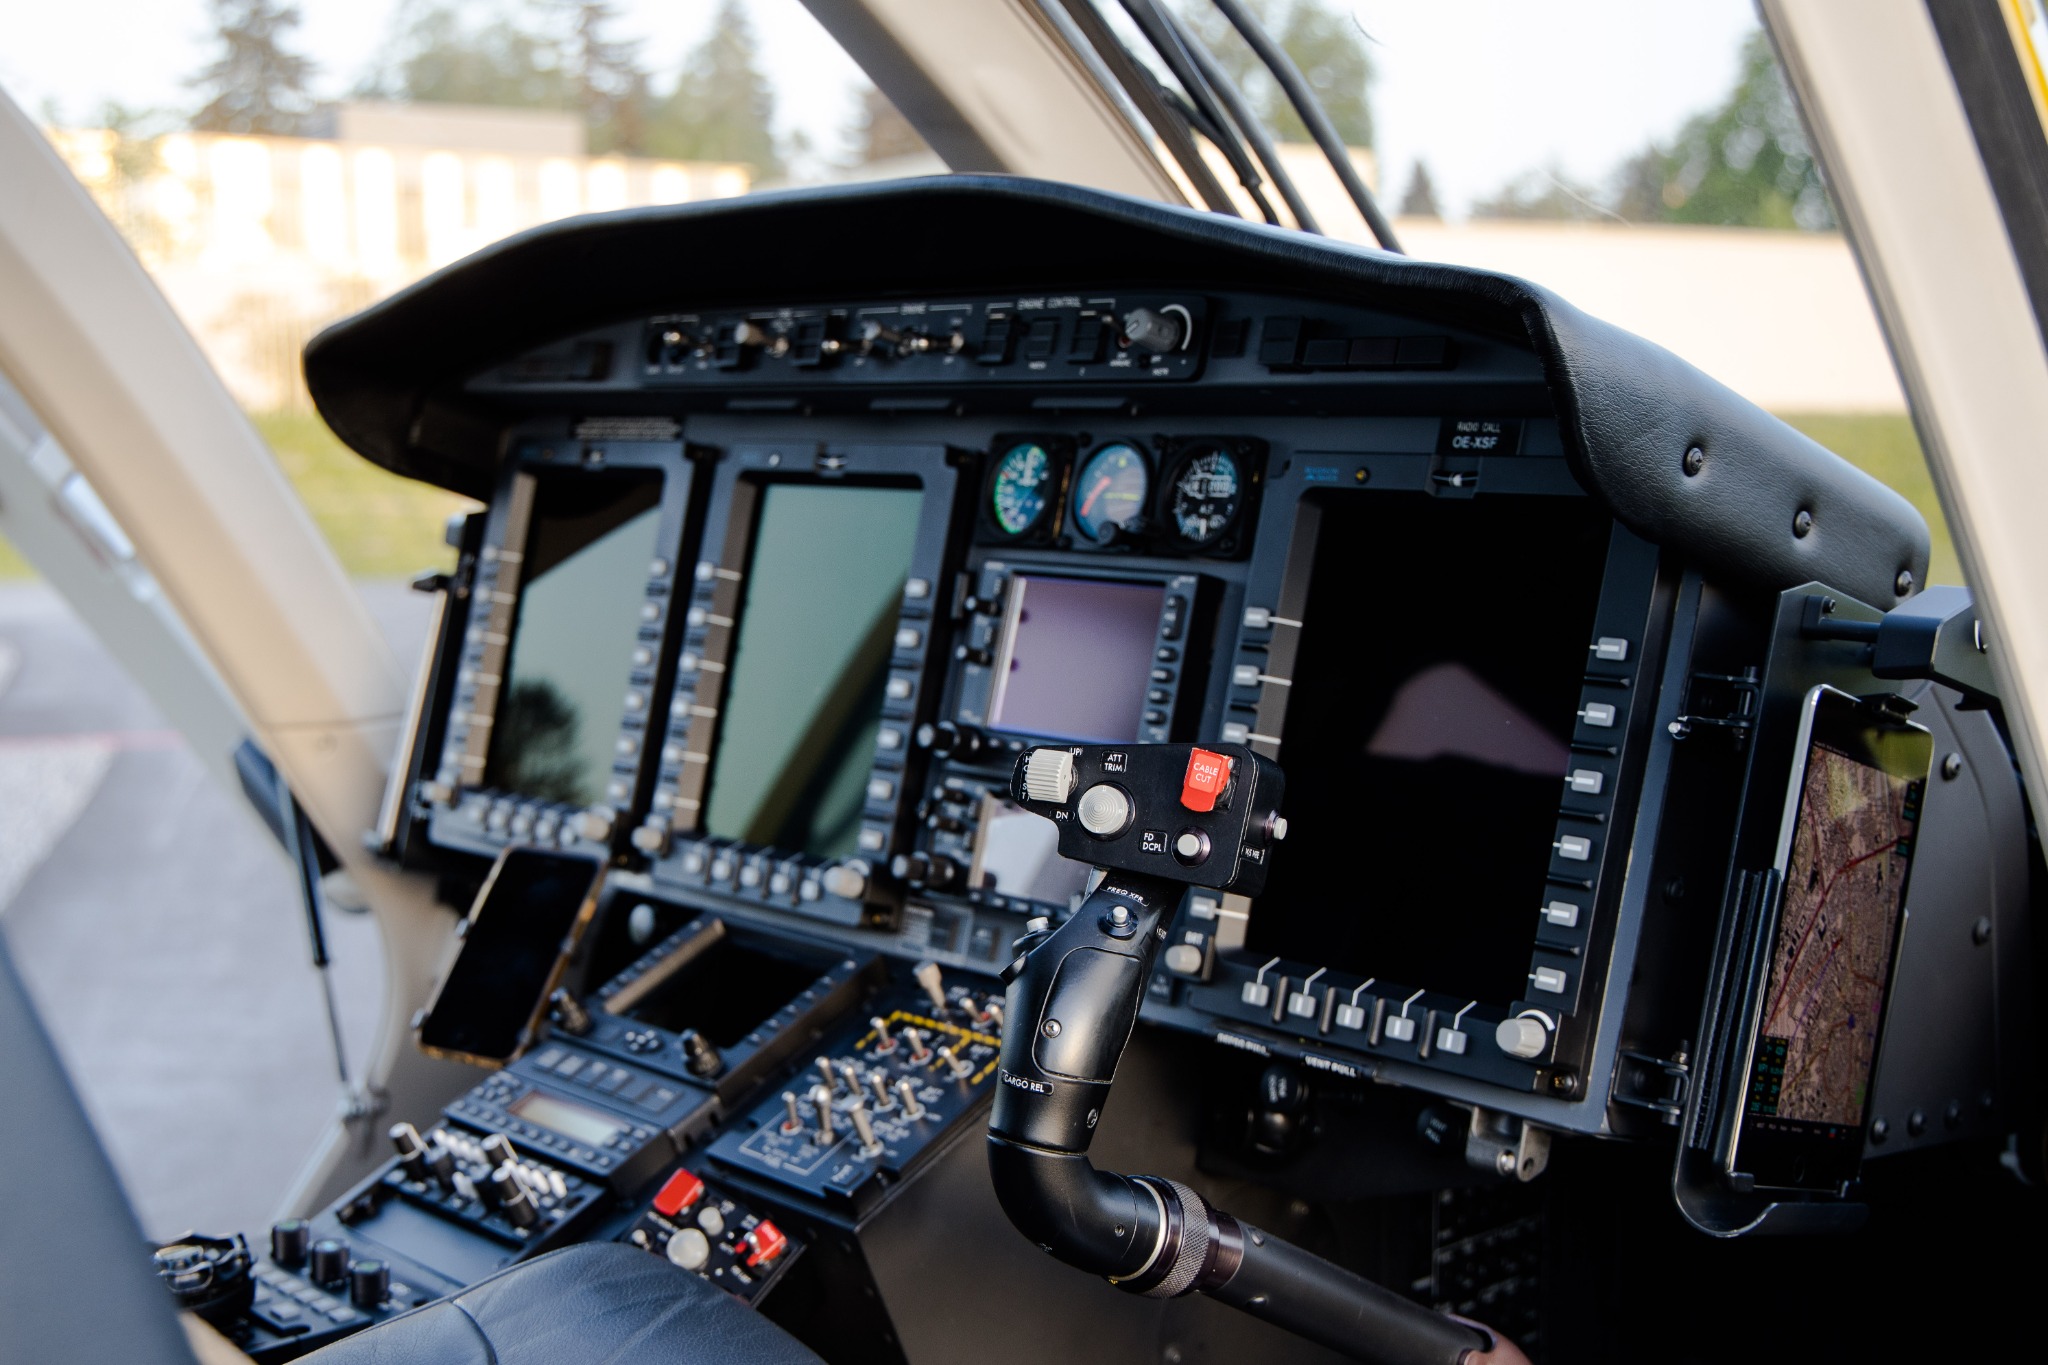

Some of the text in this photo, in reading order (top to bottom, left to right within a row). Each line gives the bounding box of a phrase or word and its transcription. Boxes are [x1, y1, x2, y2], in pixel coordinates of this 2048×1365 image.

[1457, 421, 1501, 433] RADIO CALL
[1452, 435, 1498, 449] OE-XSF
[1107, 754, 1123, 762] ATT
[1104, 763, 1122, 772] TRIM
[1193, 762, 1219, 776] CABLE
[1195, 773, 1212, 784] CUT
[1055, 811, 1068, 819] DN
[1143, 832, 1155, 842] FD
[1142, 841, 1162, 852] DCPL
[1106, 886, 1144, 903] FREQ XFR
[1305, 1055, 1357, 1078] VENT PULL
[1004, 1073, 1045, 1093] CARGO REL
